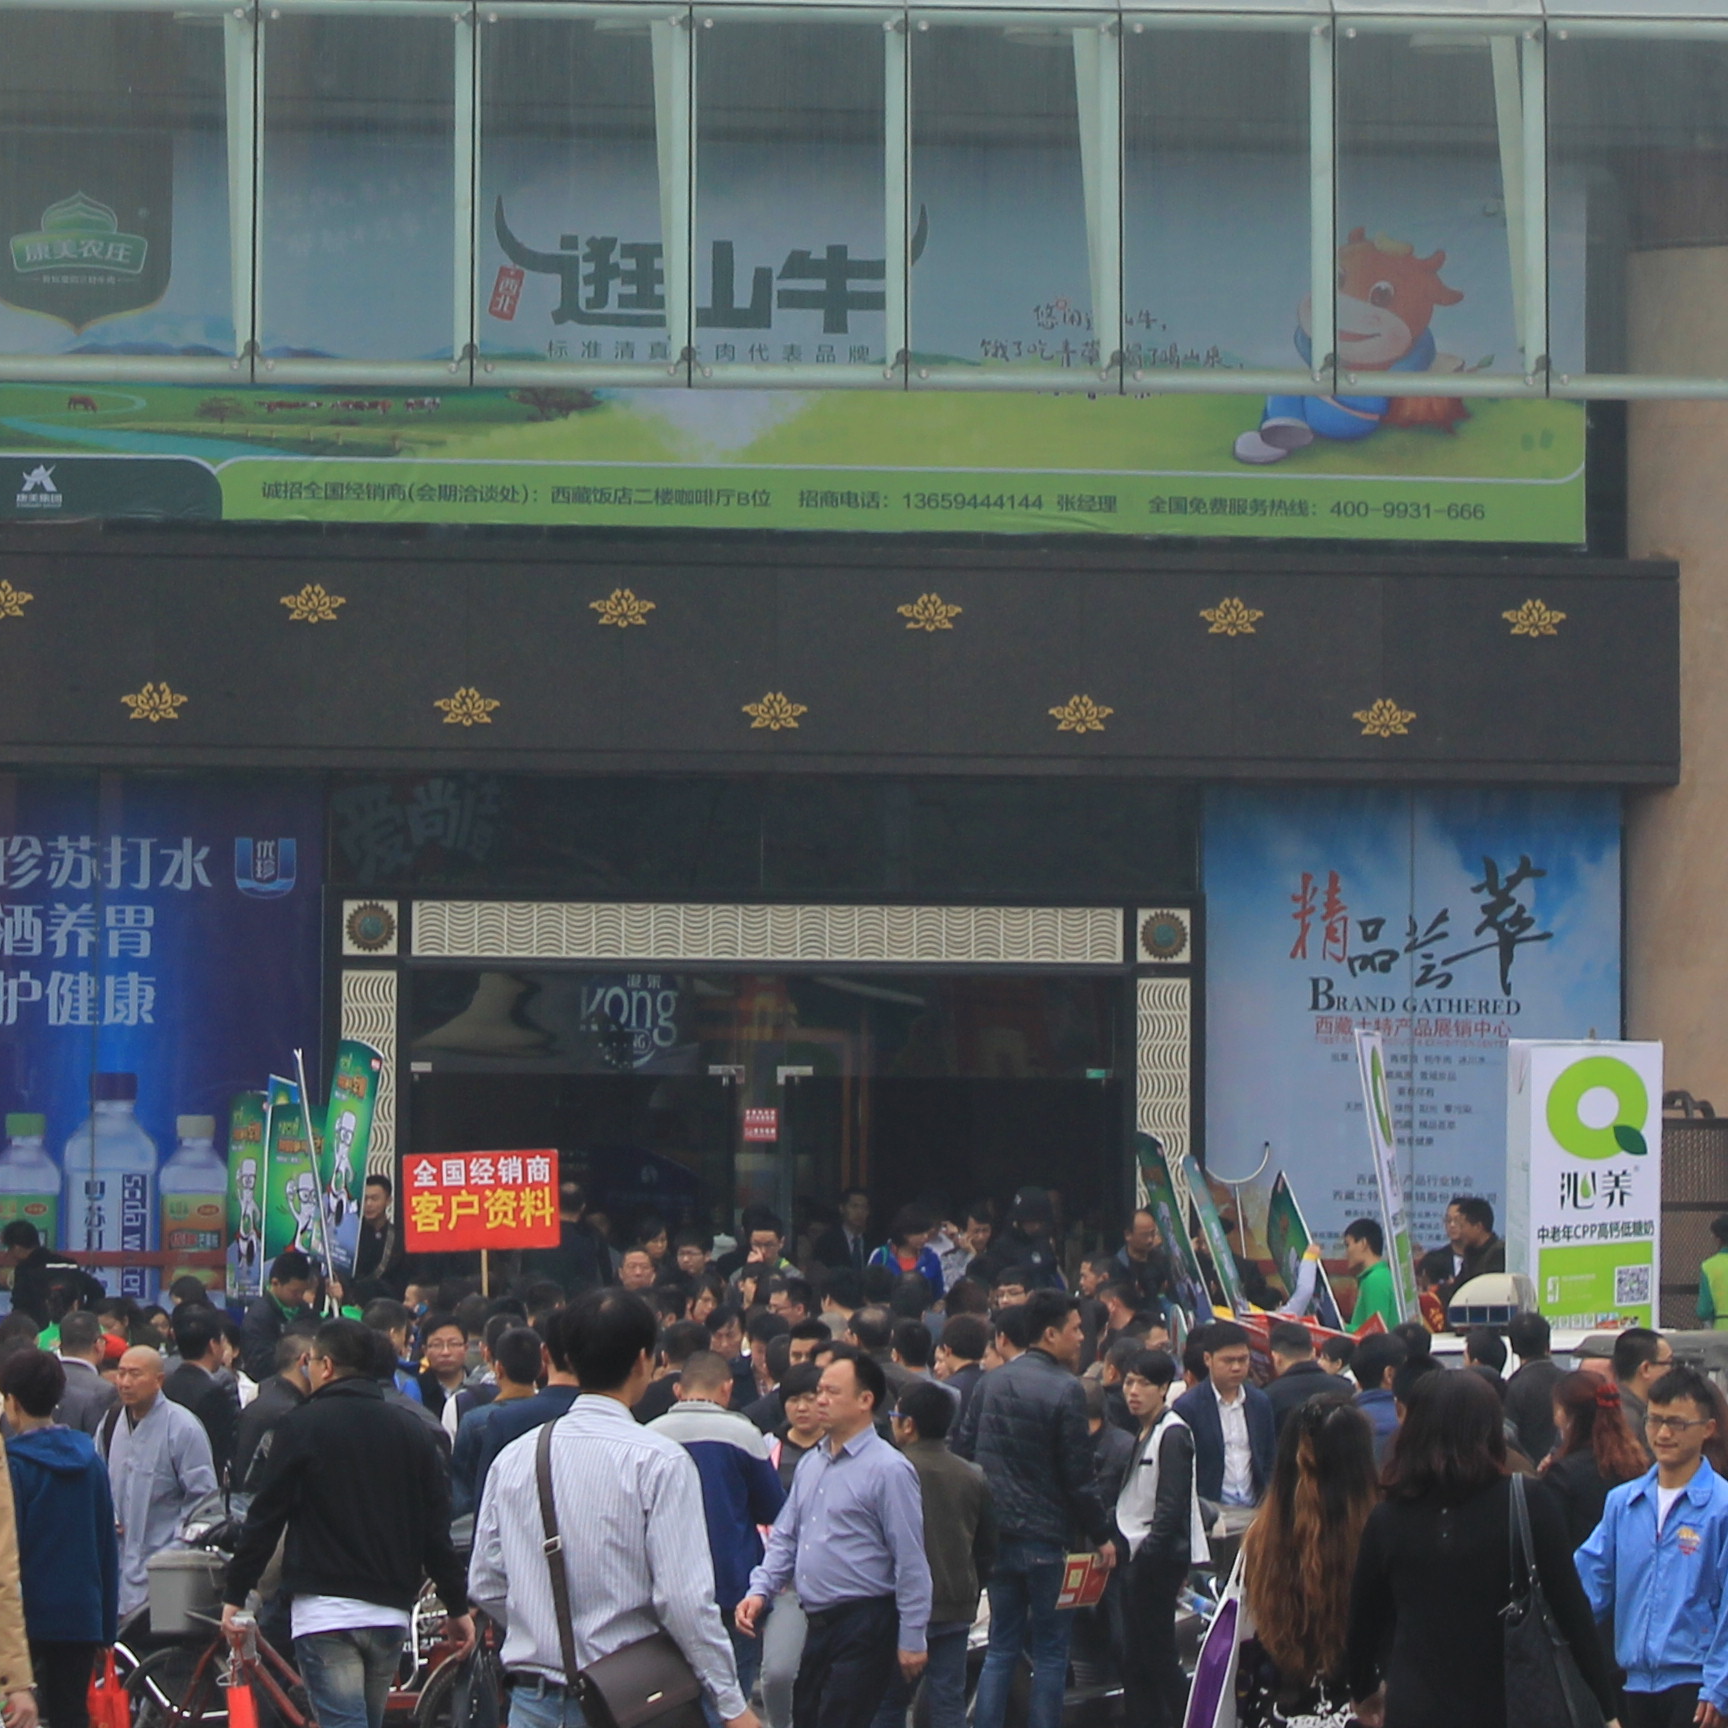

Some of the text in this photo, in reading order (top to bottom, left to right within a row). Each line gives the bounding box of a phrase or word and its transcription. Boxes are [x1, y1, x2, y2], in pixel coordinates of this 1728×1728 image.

[25, 238, 134, 263] 康美农庄
[495, 195, 928, 335] 逛山牛
[494, 278, 520, 313] 西北
[1056, 493, 1117, 513] 张经理
[1290, 855, 1554, 997] 精品荟萃
[1308, 976, 1521, 1017] BRAND GATHERED
[413, 1156, 552, 1187] 全国经销商
[1560, 1169, 1633, 1210] 沁养
[411, 1186, 555, 1234] 客户资料
[1537, 1220, 1655, 1244] 中老年CPP高钙低糖奶
